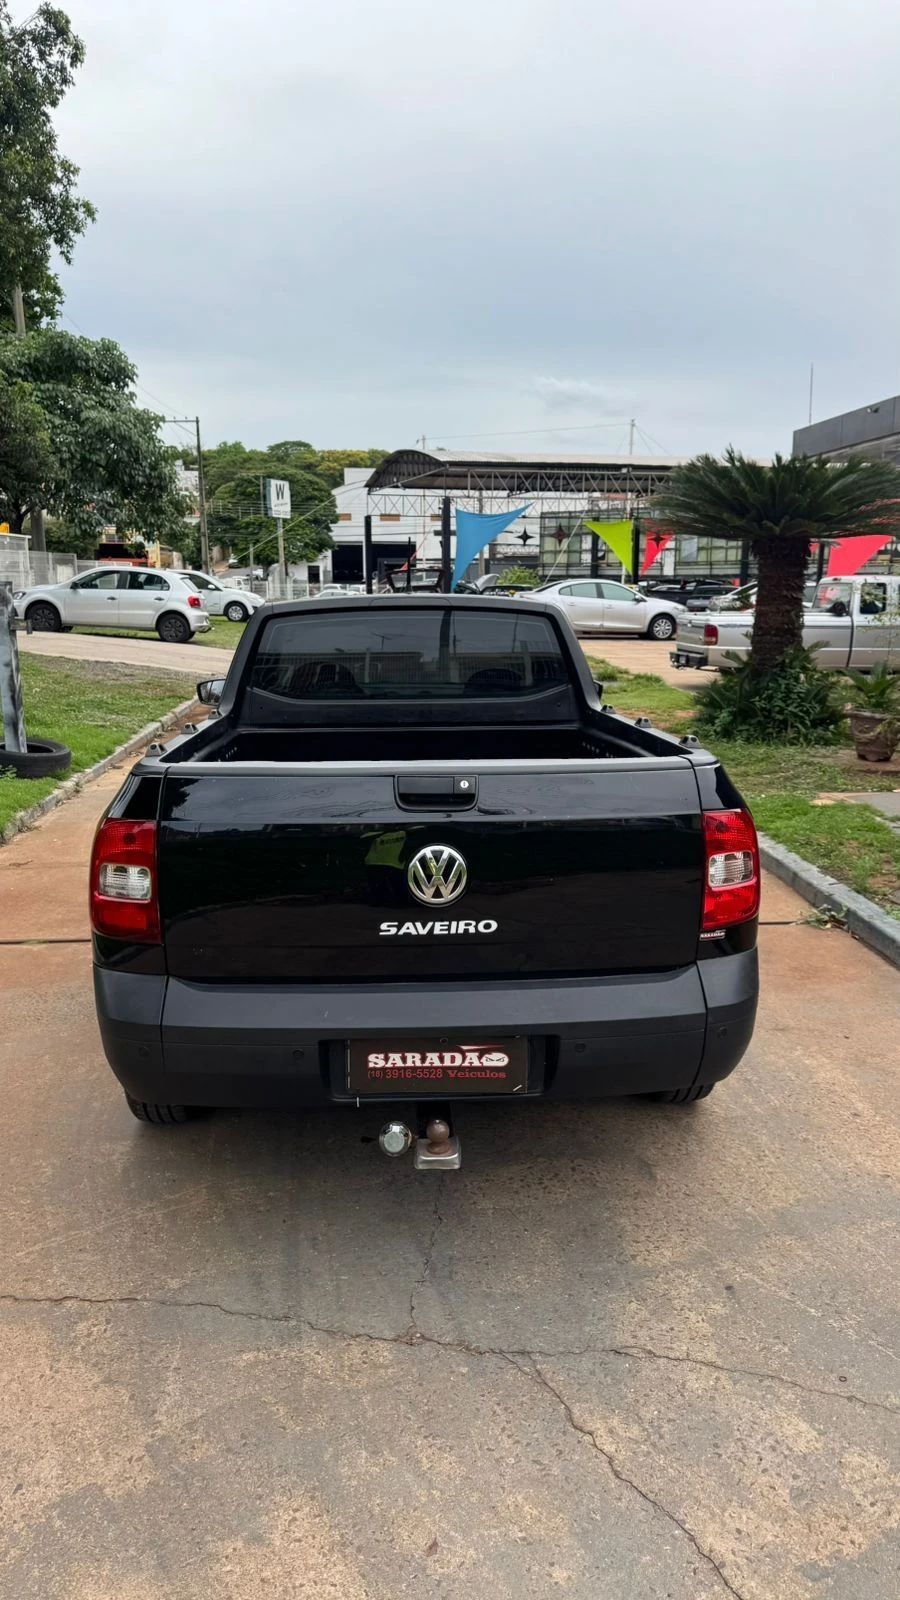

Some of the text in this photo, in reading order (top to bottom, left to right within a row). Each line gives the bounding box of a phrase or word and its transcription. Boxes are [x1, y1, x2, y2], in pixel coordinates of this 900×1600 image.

[275, 483, 285, 500] W
[379, 919, 498, 935] SAVEIRO
[385, 1068, 443, 1079] 3916-5528
